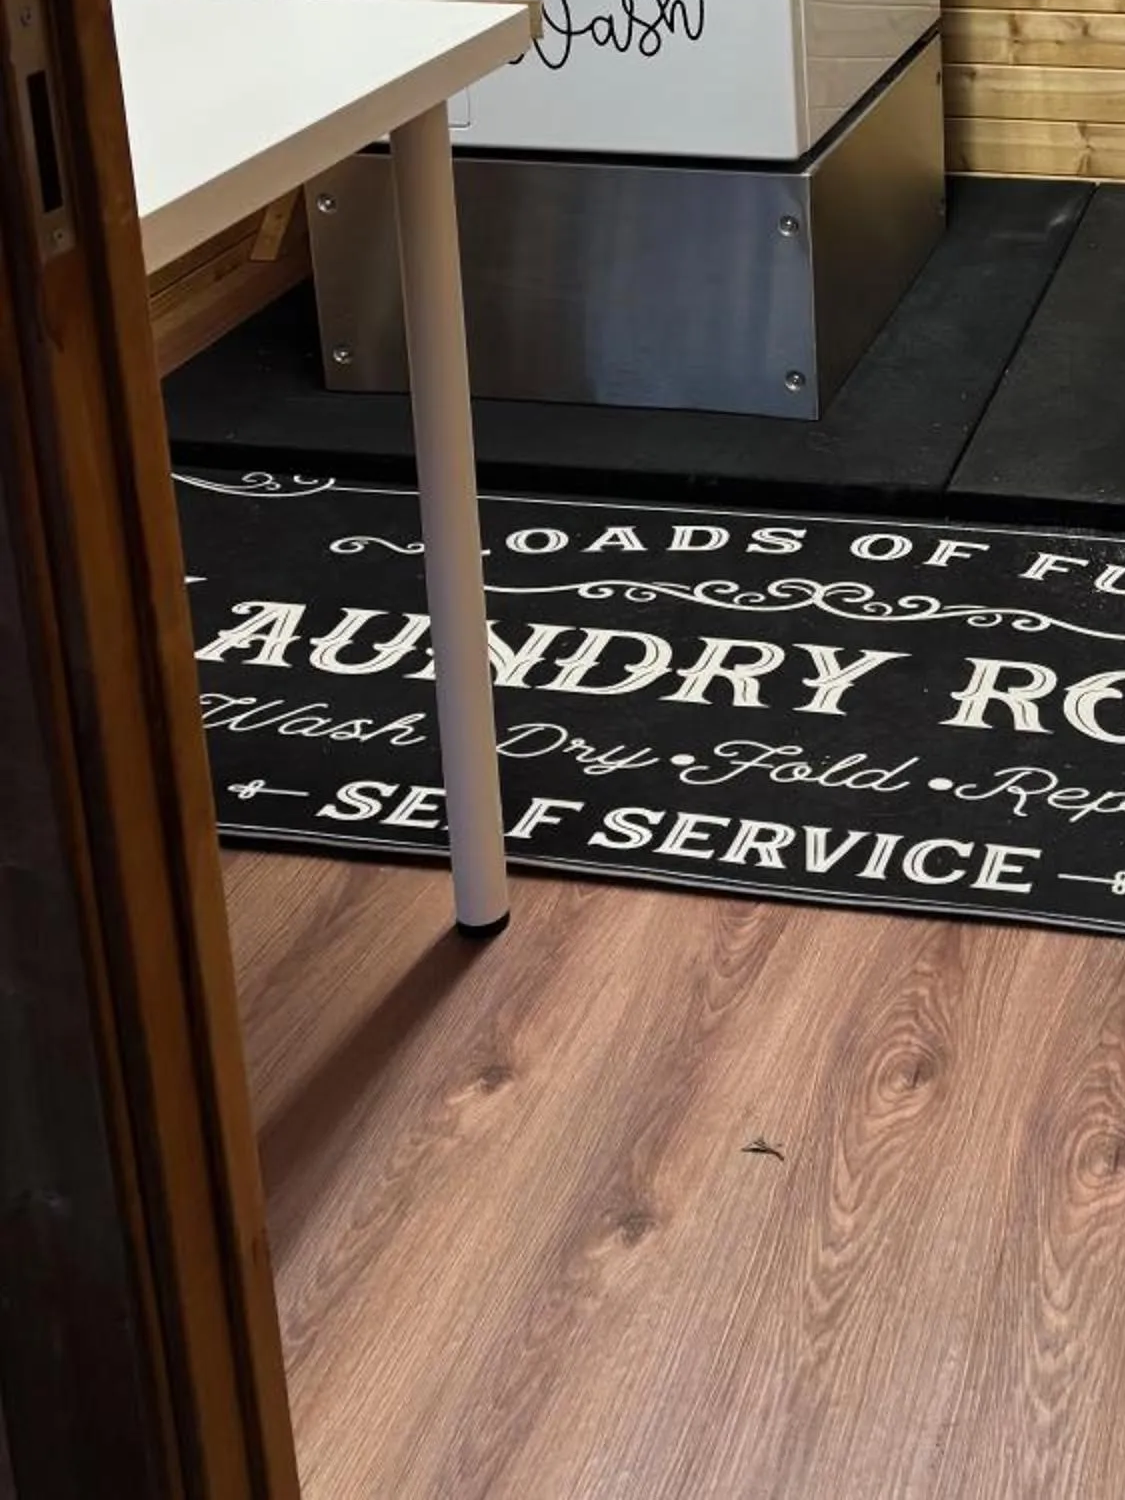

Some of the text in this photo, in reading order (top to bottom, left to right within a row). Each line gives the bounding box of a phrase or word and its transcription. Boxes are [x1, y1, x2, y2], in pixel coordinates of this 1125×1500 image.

[480, 524, 808, 556] OADS
[849, 533, 991, 567] OF
[185, 575, 913, 716] AUNDRY
[200, 692, 427, 746] Wash
[496, 723, 660, 775] Dry
[680, 740, 920, 793] Fold
[315, 780, 1042, 894] SEF SERVICE
